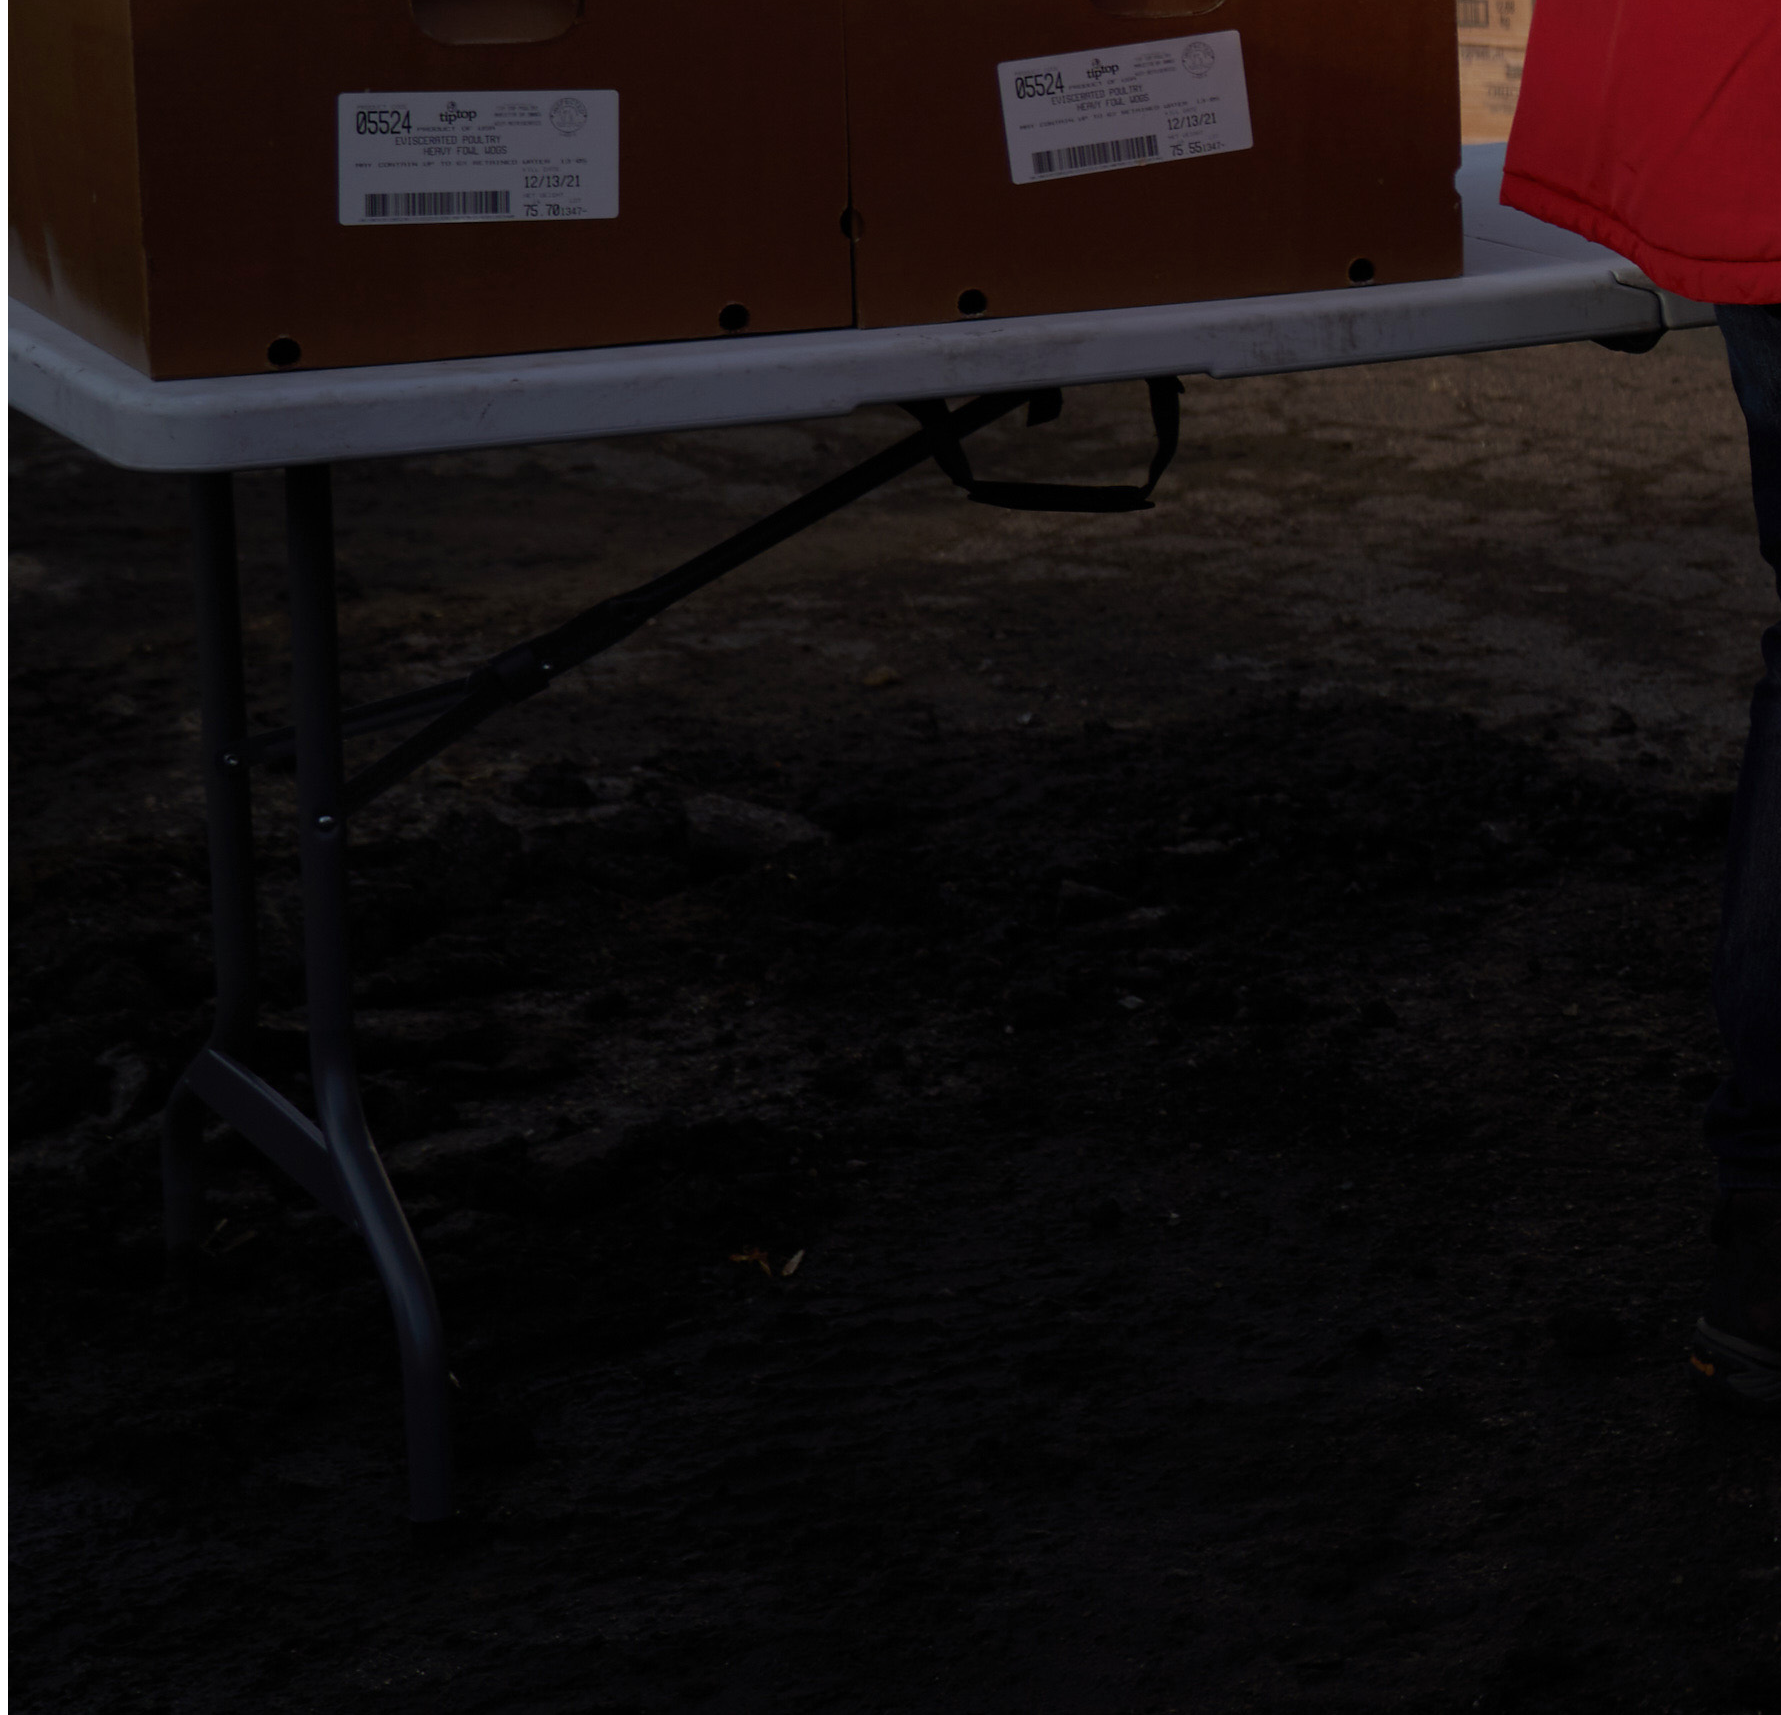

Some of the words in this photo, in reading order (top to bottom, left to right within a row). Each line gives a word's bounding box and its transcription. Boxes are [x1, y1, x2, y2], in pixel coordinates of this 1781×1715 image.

[1086, 63, 1119, 79] tiptop
[1015, 72, 1065, 99] 05524
[1051, 89, 1106, 106] EVISCERATED
[1109, 85, 1143, 97] POULTRY
[1077, 101, 1101, 112] HEAVY
[1106, 98, 1124, 108] FOWL
[356, 110, 413, 135] 05524
[439, 109, 477, 124] tiptop
[1167, 112, 1217, 131] 12/13/21
[396, 137, 458, 146] EVISCERATED
[462, 136, 500, 145] POULTRY
[423, 147, 453, 156] HEAVY
[457, 147, 478, 155] FOWL
[484, 146, 507, 155] WOGS
[524, 175, 580, 189] 12/13/21
